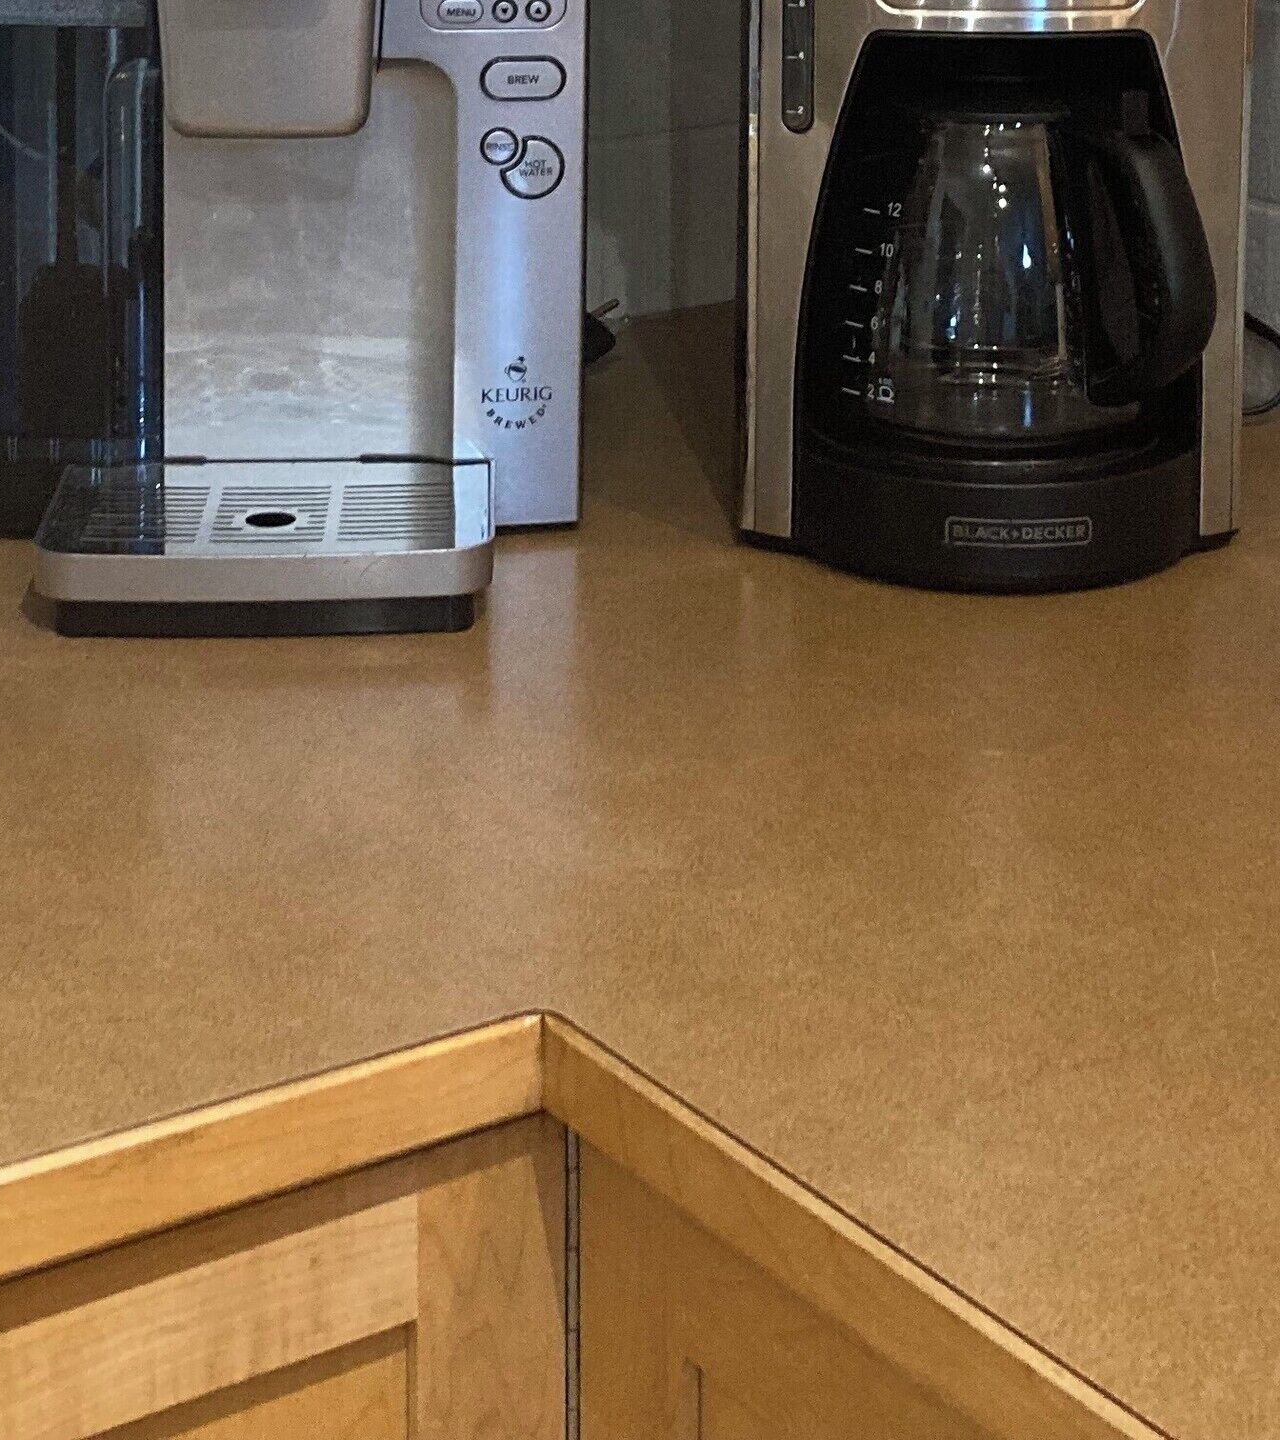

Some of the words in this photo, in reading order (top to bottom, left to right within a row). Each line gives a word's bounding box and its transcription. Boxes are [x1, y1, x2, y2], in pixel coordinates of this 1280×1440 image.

[446, 7, 476, 17] MENU
[506, 74, 540, 85] BREW
[524, 159, 547, 168] HOT
[519, 167, 554, 177] WATER
[887, 201, 903, 218] 12
[879, 242, 895, 258] 10
[874, 279, 883, 295] 8
[870, 315, 879, 330] 6
[867, 351, 876, 365] 4
[480, 386, 553, 404] KEURIG
[866, 383, 876, 400] 2
[485, 407, 547, 430] BREWED
